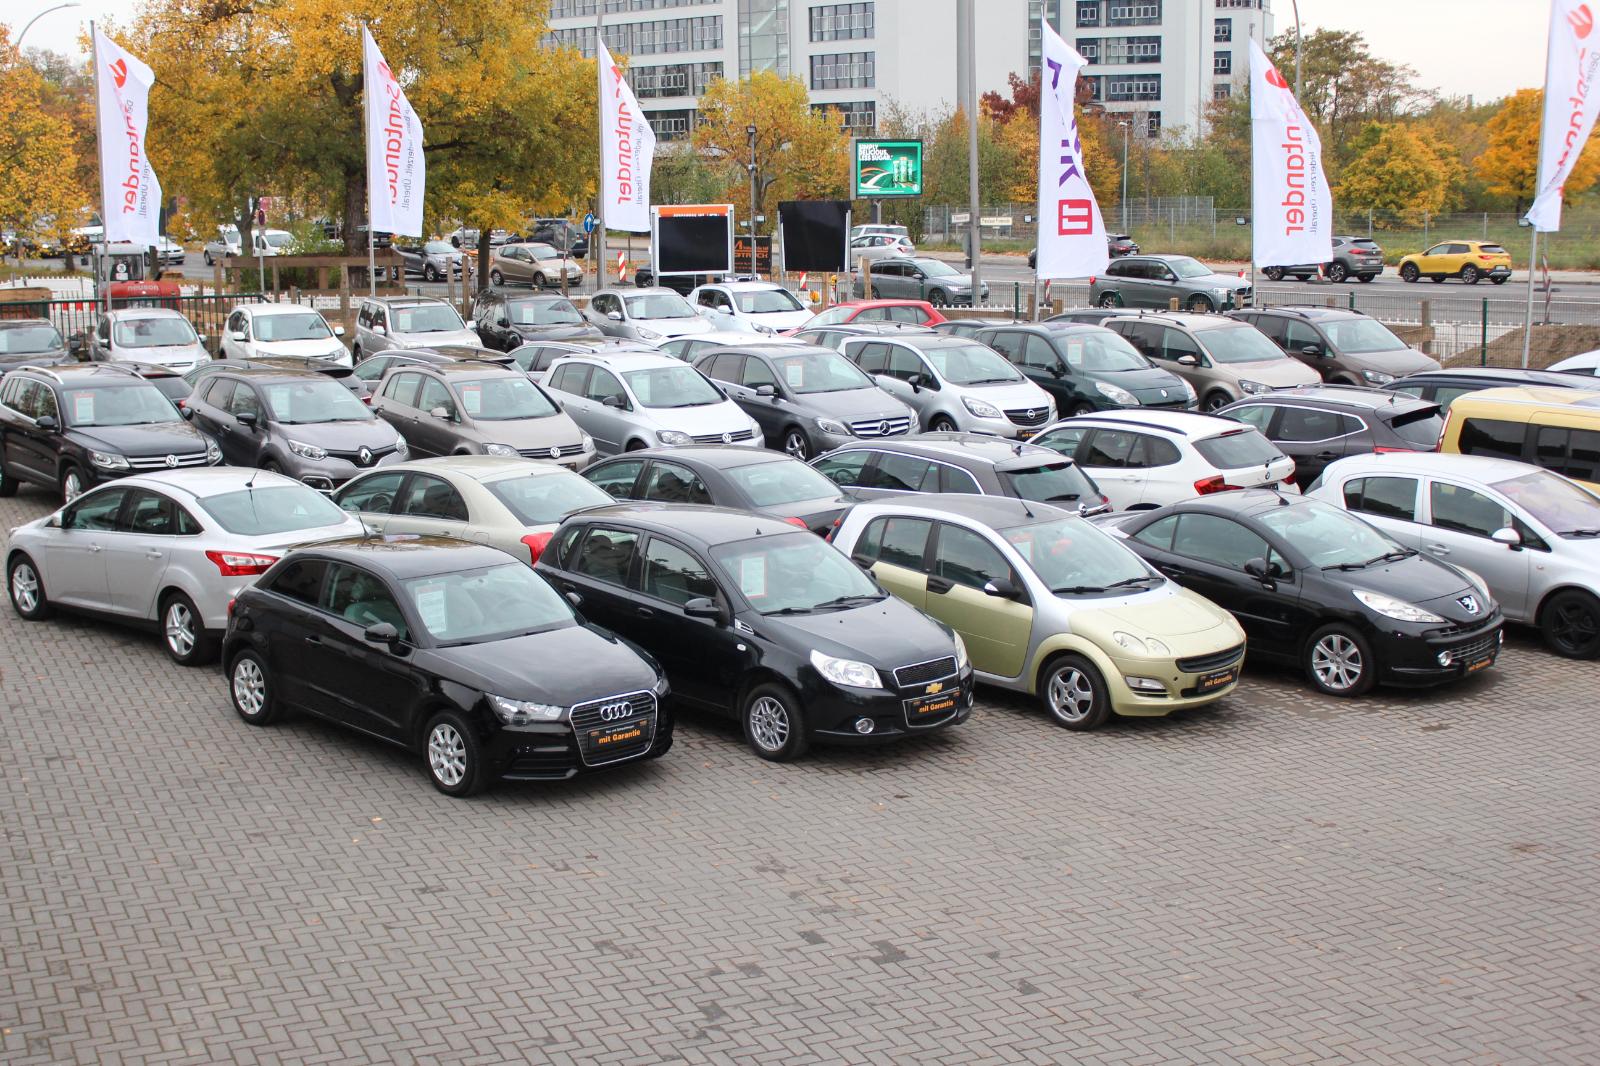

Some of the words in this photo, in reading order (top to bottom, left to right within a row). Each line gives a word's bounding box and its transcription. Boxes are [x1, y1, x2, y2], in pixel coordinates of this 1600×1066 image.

[930, 699, 954, 711] Garantie
[598, 735, 611, 744] mit
[612, 729, 641, 741] Garantie
